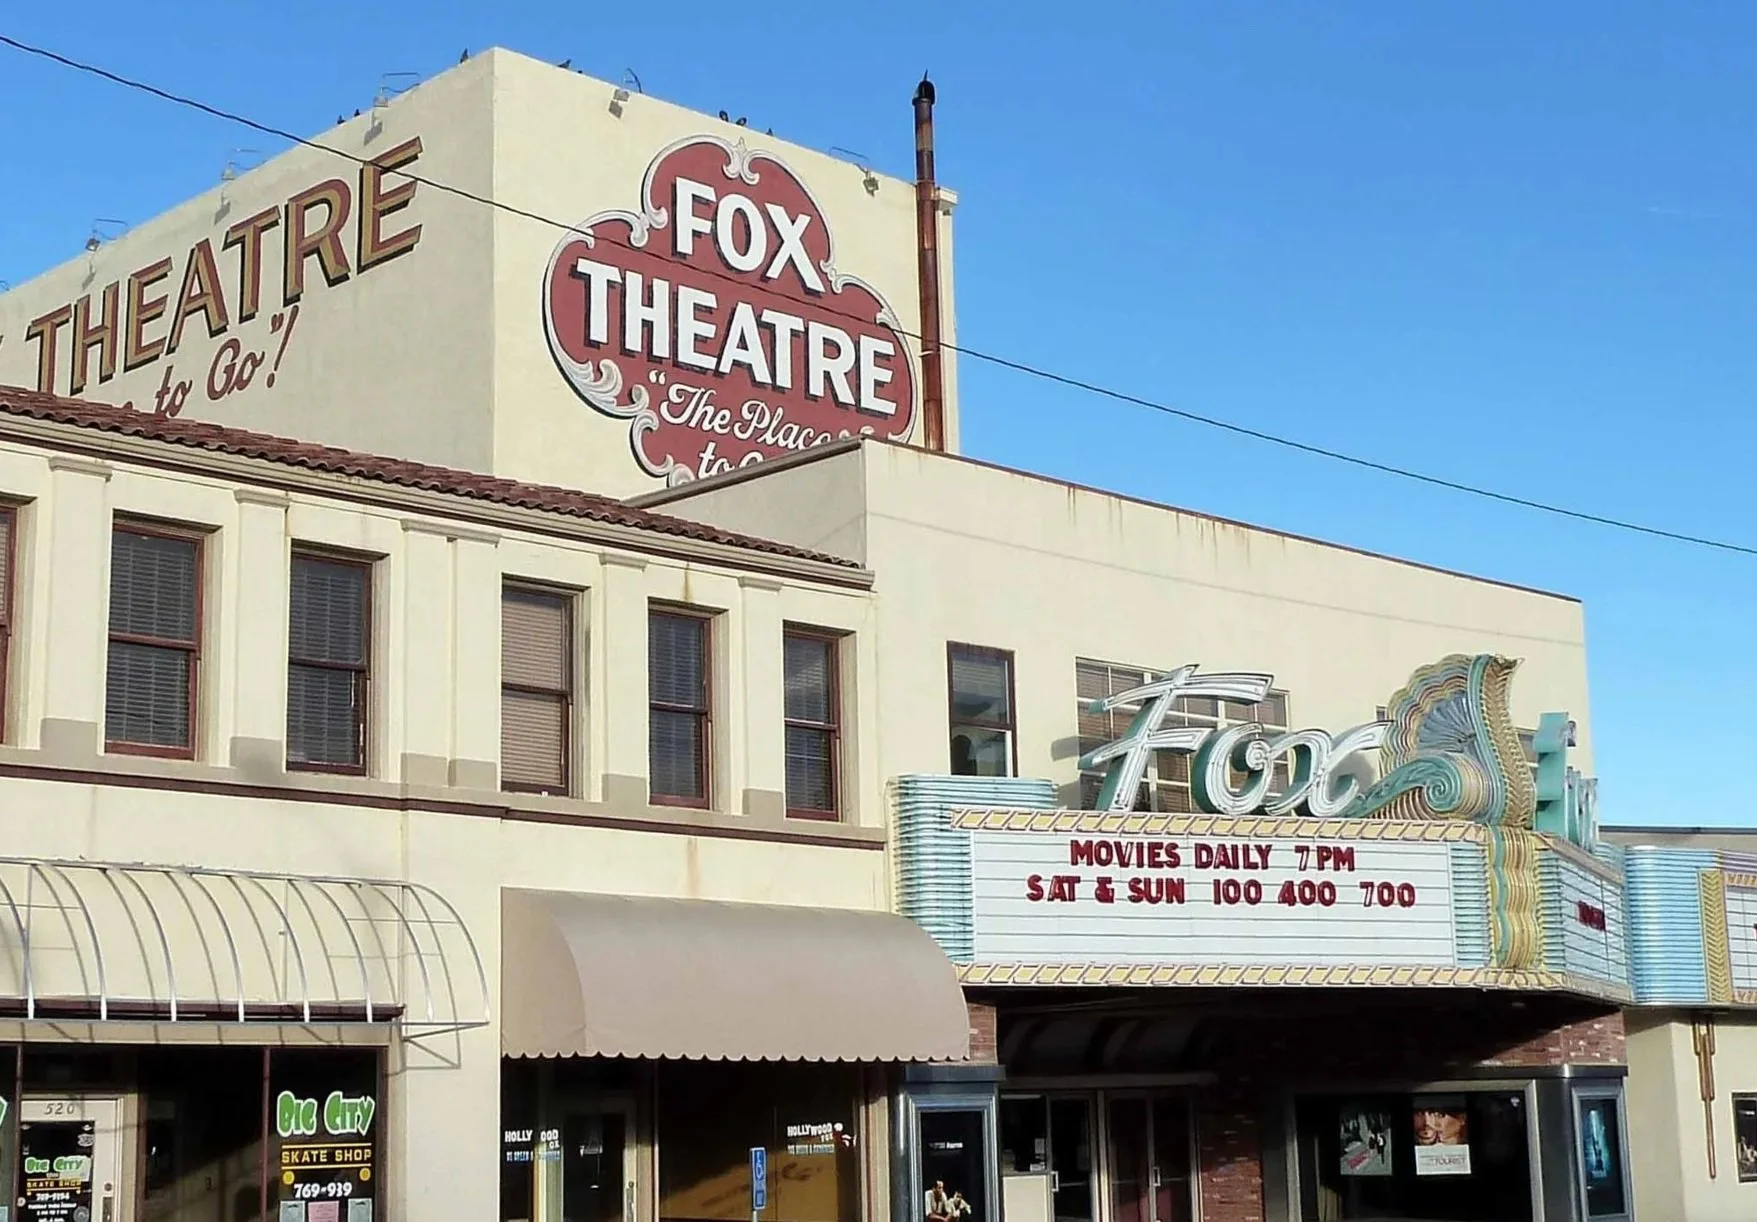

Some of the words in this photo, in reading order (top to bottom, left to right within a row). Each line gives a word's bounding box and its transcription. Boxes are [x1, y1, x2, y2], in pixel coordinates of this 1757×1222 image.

[673, 176, 826, 295] FOX
[25, 136, 423, 397] THEATRE
[569, 257, 898, 418] THEATRE
[1078, 663, 1398, 818] Fox
[1070, 839, 1182, 869] MOVIES
[1194, 842, 1273, 871] DAILY
[1027, 875, 1081, 903] SAT
[1095, 877, 1115, 904] &
[1127, 877, 1186, 905] SUN
[1213, 879, 1263, 906] 100
[1278, 880, 1337, 907] 400
[1359, 881, 1416, 908] 700
[44, 1102, 75, 1115] 520
[787, 1123, 833, 1137] HOLLYWOOD
[281, 1151, 327, 1163] SKATE
[335, 1149, 371, 1160] SHOP
